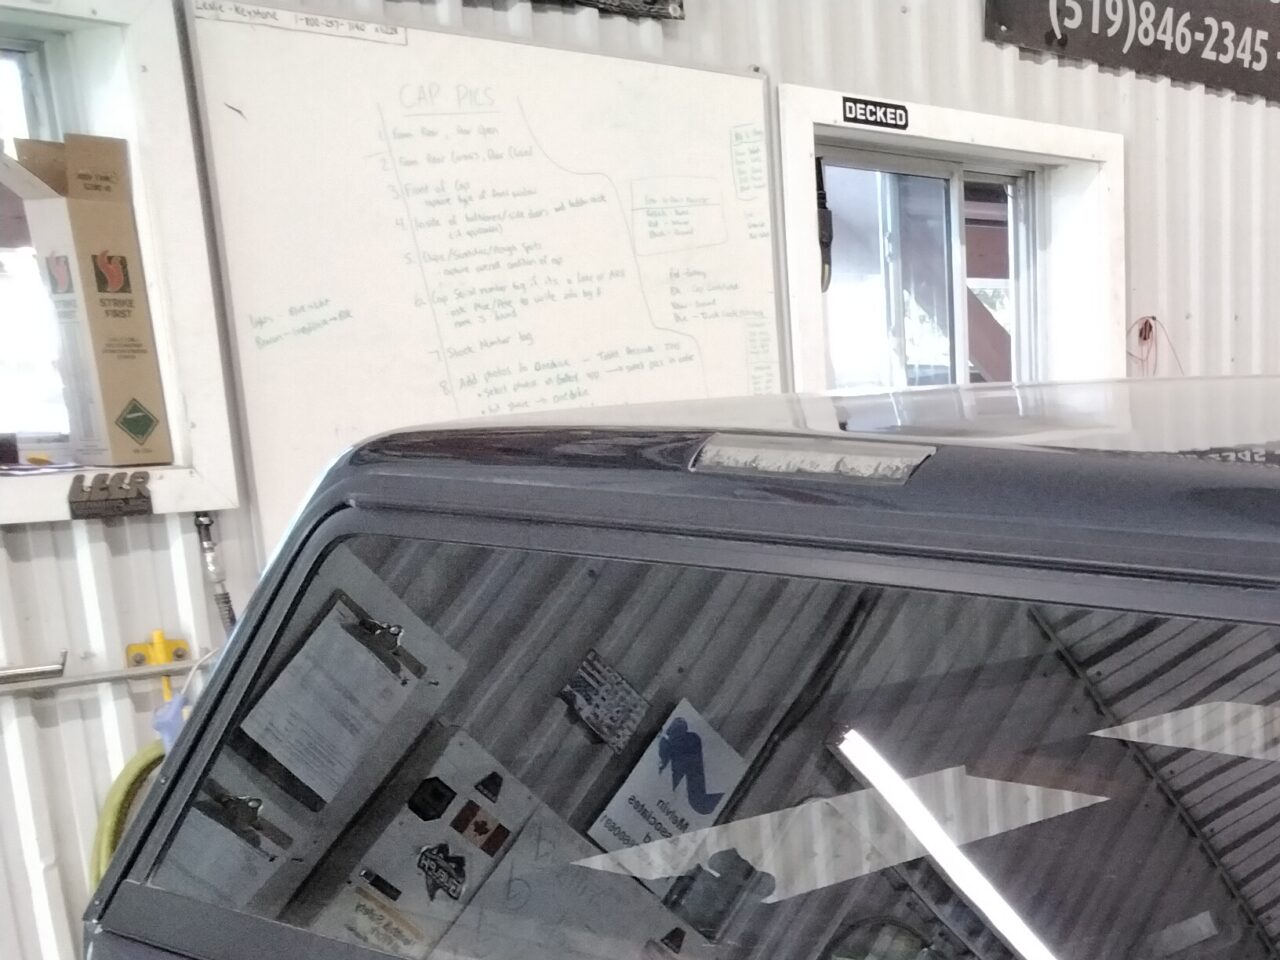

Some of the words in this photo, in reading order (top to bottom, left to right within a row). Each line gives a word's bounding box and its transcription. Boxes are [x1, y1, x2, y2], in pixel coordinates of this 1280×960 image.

[1049, 0, 1269, 72] (519)846-2345
[399, 82, 441, 108] CAP
[456, 84, 495, 110] PICS
[845, 101, 906, 126] DECKED
[99, 298, 135, 309] STRIKE
[104, 309, 133, 319] FIRST
[68, 470, 152, 503] LEER
